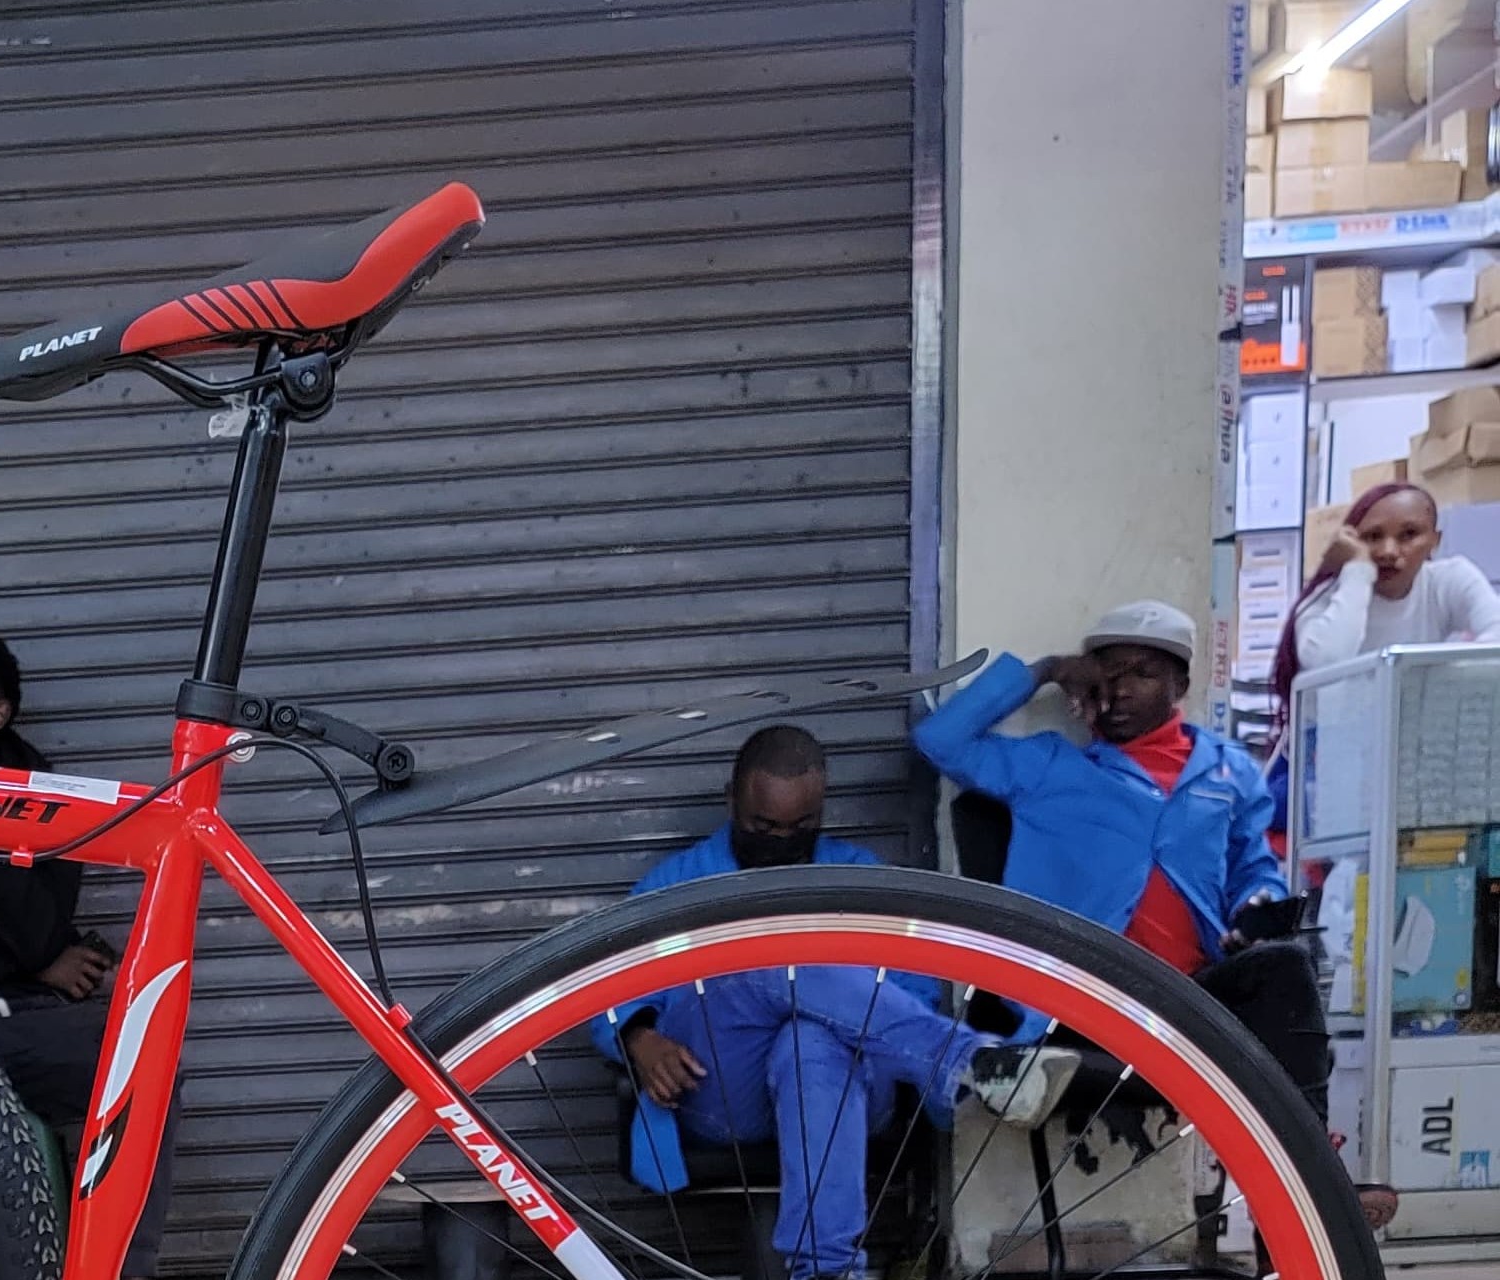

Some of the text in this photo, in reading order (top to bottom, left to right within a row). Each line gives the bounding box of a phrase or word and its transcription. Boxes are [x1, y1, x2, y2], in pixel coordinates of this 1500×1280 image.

[19, 326, 104, 361] PLANET
[1421, 1097, 1454, 1157] ADL
[435, 1102, 559, 1221] PLANET
